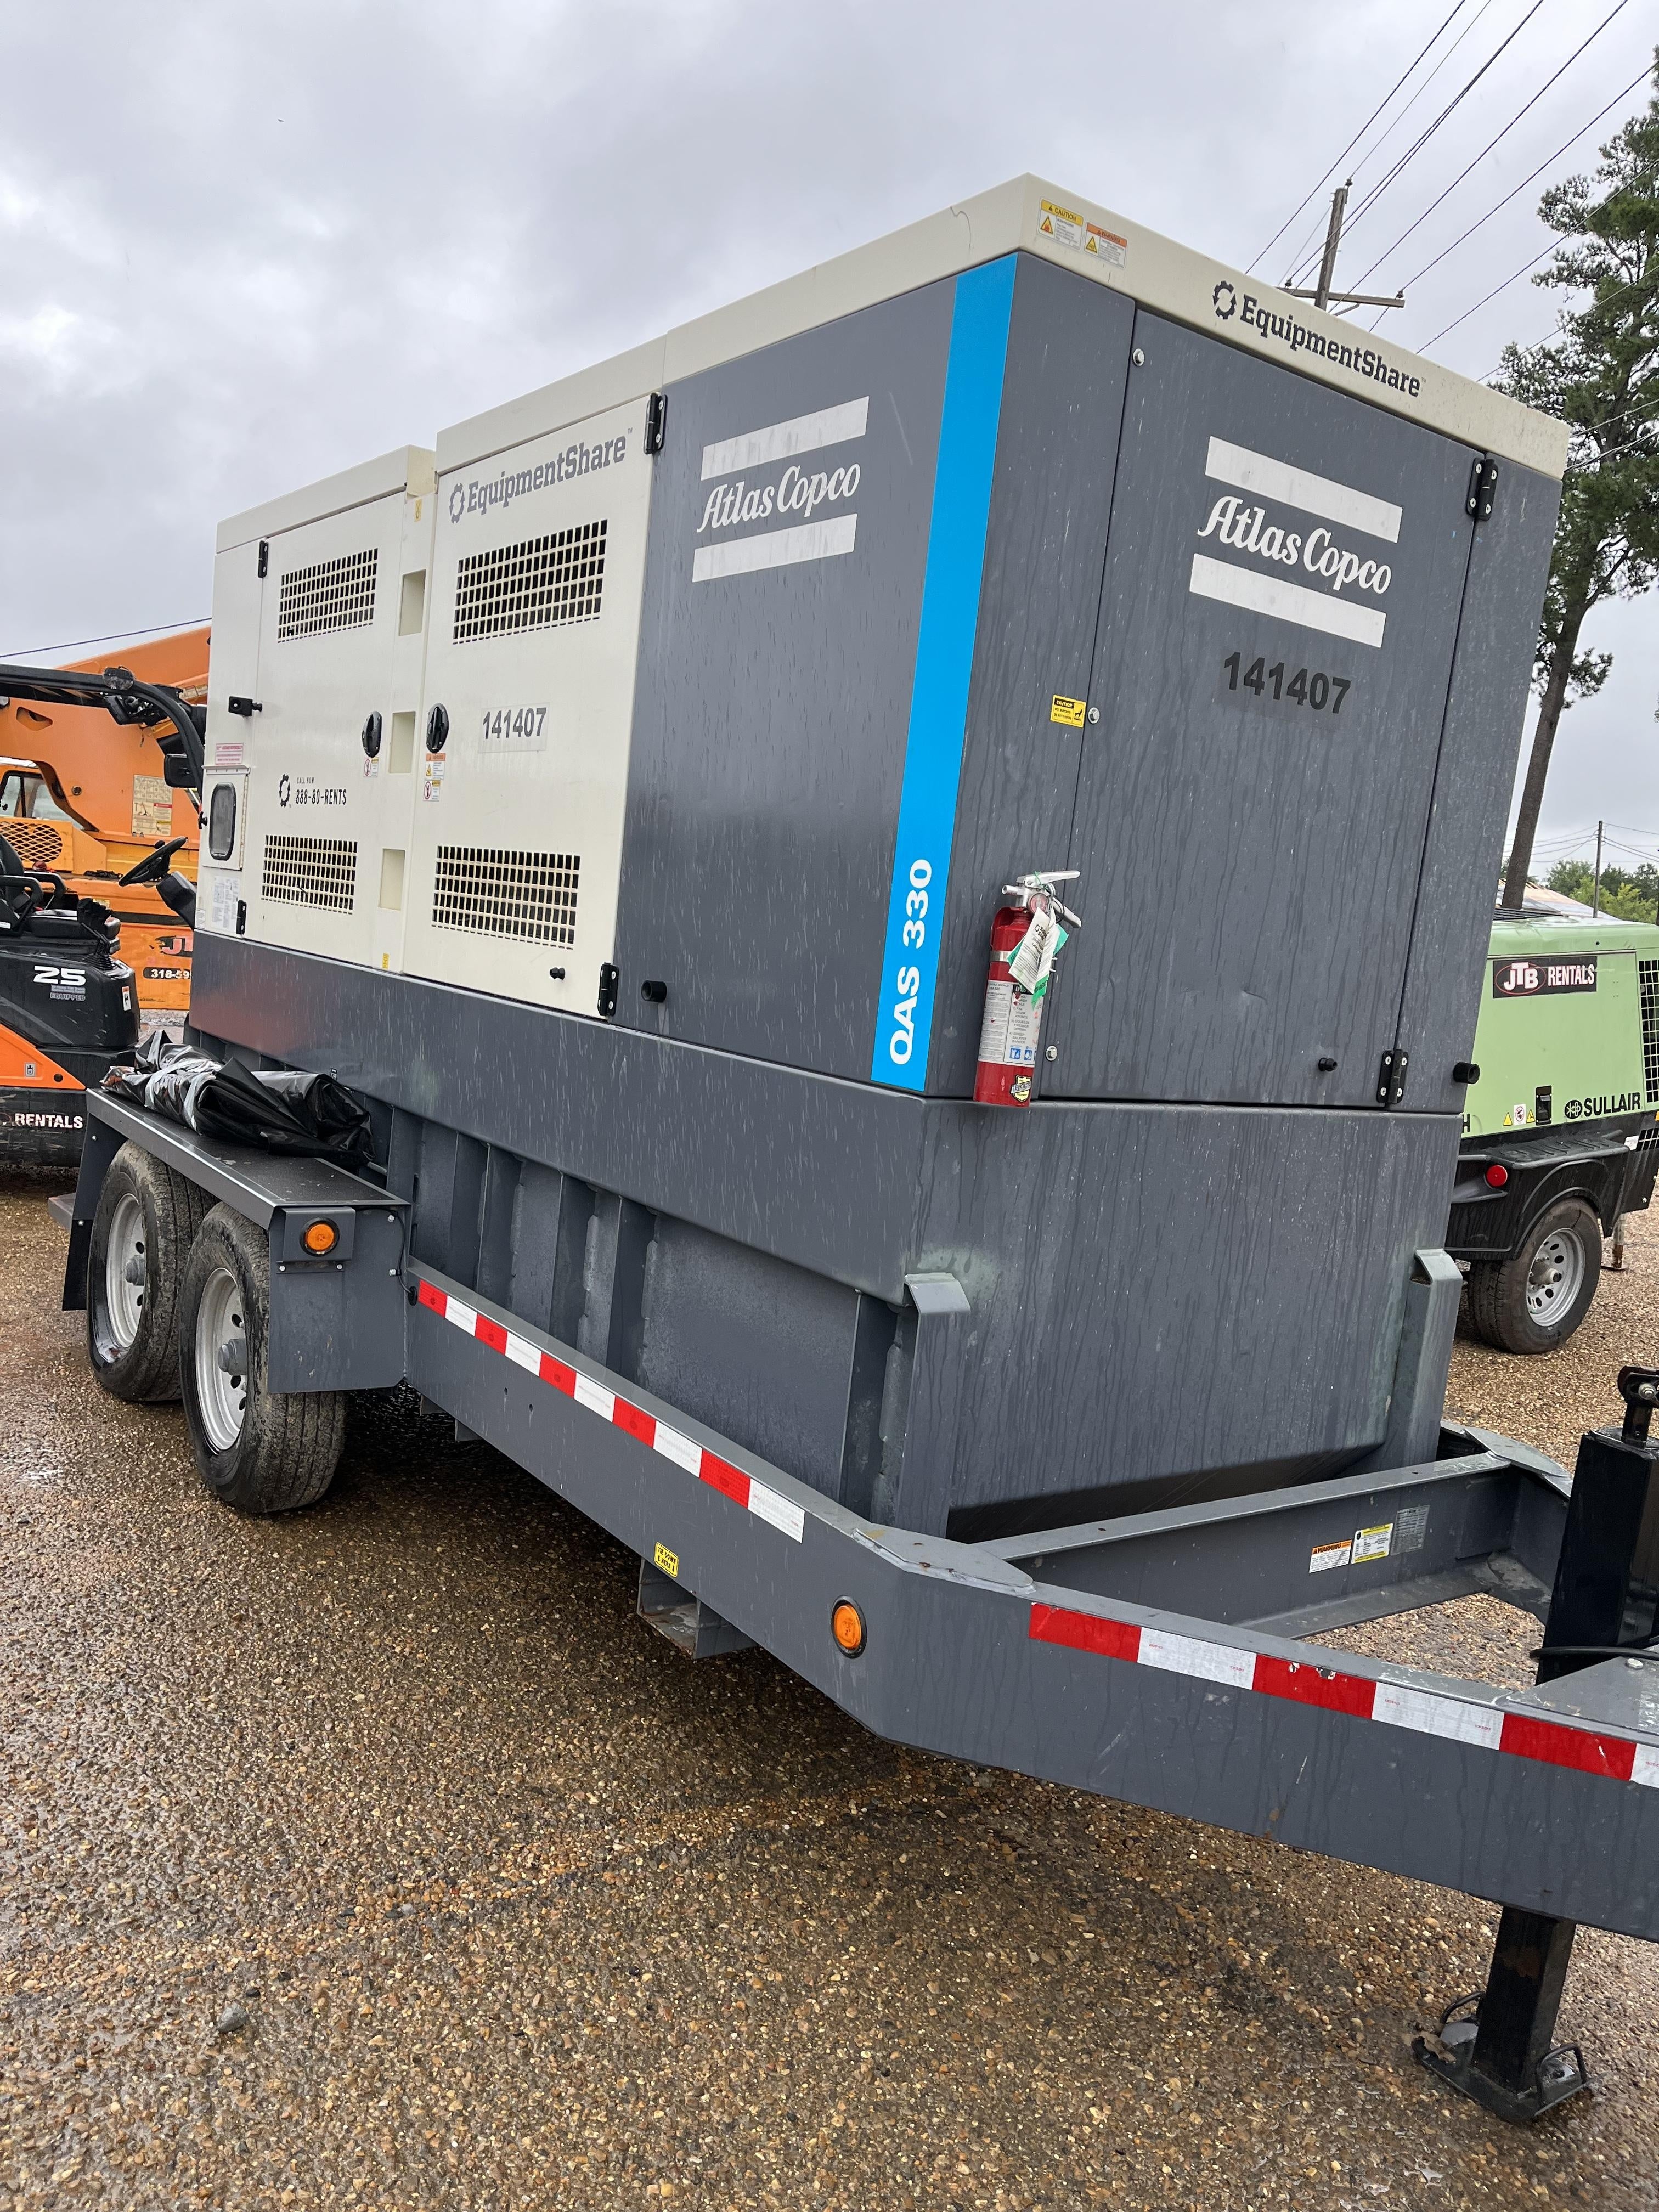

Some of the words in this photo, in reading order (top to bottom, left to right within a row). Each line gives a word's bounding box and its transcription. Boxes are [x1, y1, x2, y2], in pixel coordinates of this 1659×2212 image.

[1054, 207, 1076, 222] CAUTION
[1240, 293, 1421, 398] EquipmentShare
[467, 435, 627, 515] EquipmentShare
[696, 481, 775, 533] Atlas
[777, 463, 861, 517] Copco
[1197, 495, 1301, 566] Atlas
[1304, 528, 1392, 594] Copco
[1224, 651, 1352, 715] 141407
[483, 707, 547, 740] 141407
[296, 789, 347, 805] 888-80-RENTS
[902, 859, 932, 949] 330
[162, 935, 193, 955] JT
[33, 965, 86, 986] 25
[151, 969, 192, 979] 318-59
[1503, 962, 1539, 991] JTB
[1548, 963, 1595, 987] RENTALS
[50, 992, 86, 1001] EQUIPPED
[889, 966, 921, 1065] QAS
[1583, 1092, 1641, 1116] SULLAIR
[15, 1113, 83, 1129] RENTALS
[665, 1552, 676, 1564] DOWN
[1318, 1543, 1341, 1553] WARNING
[661, 1558, 670, 1569] HERE
